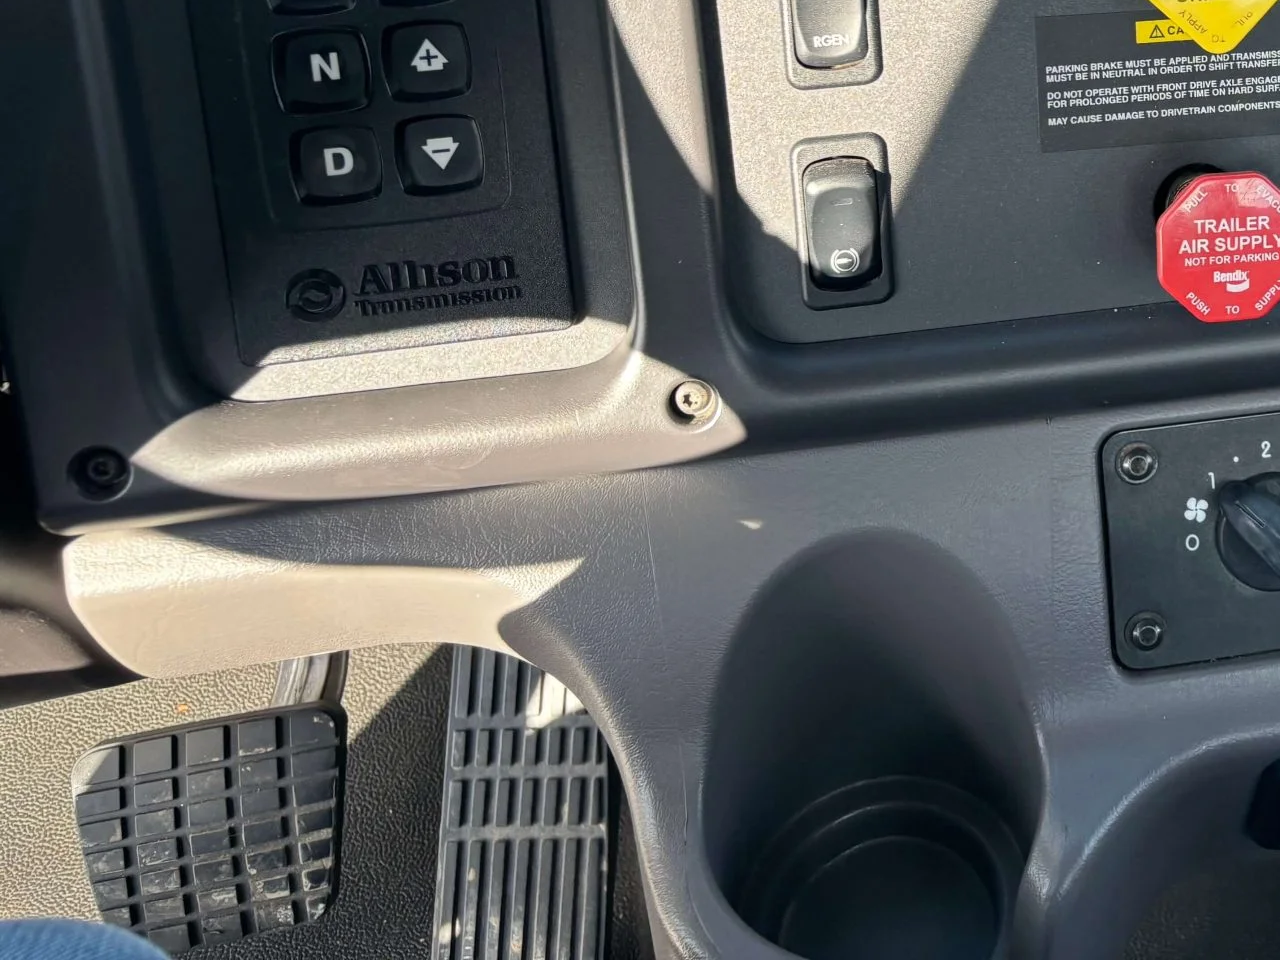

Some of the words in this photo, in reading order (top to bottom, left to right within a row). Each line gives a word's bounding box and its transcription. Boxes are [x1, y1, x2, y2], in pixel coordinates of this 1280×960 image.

[813, 35, 850, 48] RGEN
[310, 52, 341, 82] N
[1045, 63, 1088, 74] PARKING
[1090, 61, 1123, 71] BRAKE
[1125, 59, 1151, 69] MUST
[1153, 58, 1167, 67] BE
[1168, 55, 1208, 65] APPLIED
[1210, 53, 1230, 62] AND
[1045, 73, 1073, 83] MUST
[1075, 72, 1089, 81] BE
[1090, 71, 1100, 80] IN
[1102, 68, 1146, 79] NEUTRAL
[1148, 66, 1158, 75] IN
[1159, 64, 1193, 75] ORDER
[1195, 63, 1207, 73] TO
[1208, 61, 1235, 71] SHIFT
[1047, 91, 1061, 101] DO
[1063, 90, 1083, 100] NOT
[1085, 86, 1129, 98] OPERATE
[1130, 85, 1154, 95] WITH
[1156, 82, 1188, 93] FRONT
[1189, 80, 1217, 90] DRIVE
[1219, 78, 1244, 88] AXLE
[1047, 99, 1068, 109] FOR
[1069, 96, 1129, 107] PROLONGED
[1131, 92, 1172, 103] PERIODS
[1174, 90, 1188, 99] OF
[1188, 88, 1210, 98] TIME
[1211, 87, 1226, 97] ON
[1227, 85, 1254, 95] HARD
[1048, 117, 1068, 126] MAY
[1070, 114, 1103, 125] CAUSE
[1104, 110, 1145, 122] DAMAGE
[1146, 109, 1160, 119] TO
[1161, 105, 1216, 117] DRIVETRAIN
[324, 147, 354, 176] D
[1181, 190, 1209, 215] PULL
[1224, 183, 1240, 193] TO
[1194, 215, 1271, 235] TRAILER
[1178, 238, 1210, 255] AIR
[1184, 256, 1207, 267] NOT
[1209, 255, 1232, 265] FOR
[1233, 251, 1280, 263] PARKING
[353, 256, 520, 296] Allison
[1213, 269, 1250, 283] Bendix
[354, 286, 522, 317] Transmission
[1185, 291, 1211, 316] PUSH
[1225, 305, 1240, 315] TO
[1261, 441, 1272, 458] 2
[1207, 472, 1216, 490] 1
